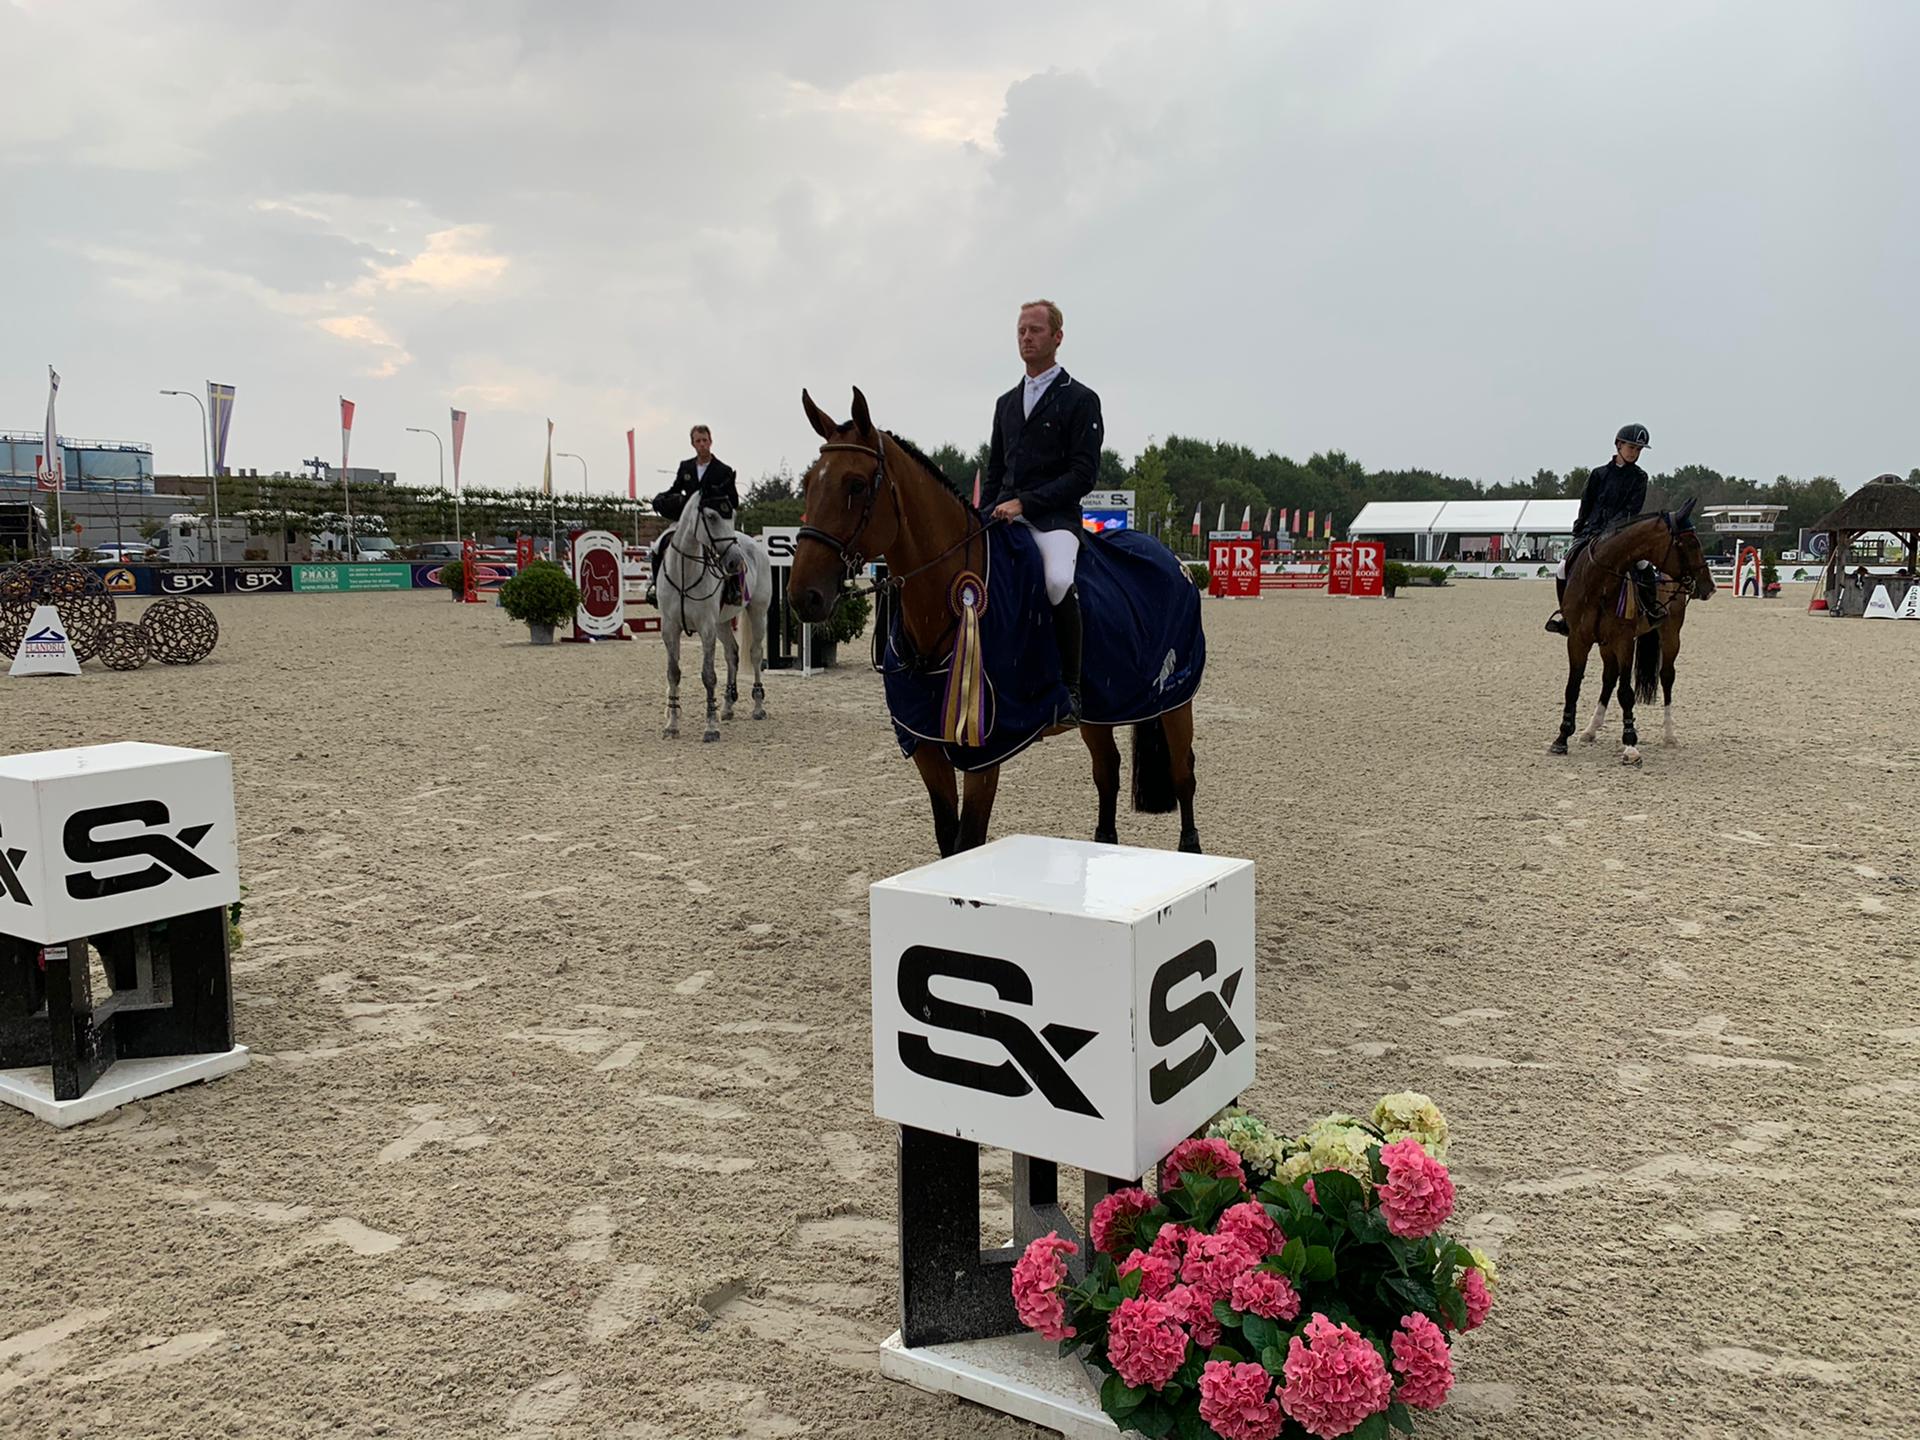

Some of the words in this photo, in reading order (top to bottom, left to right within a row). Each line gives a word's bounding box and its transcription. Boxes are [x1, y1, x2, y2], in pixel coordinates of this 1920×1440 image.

[1232, 547, 1255, 571] R
[1356, 547, 1378, 571] R
[172, 574, 214, 588] STX
[246, 574, 283, 586] STX
